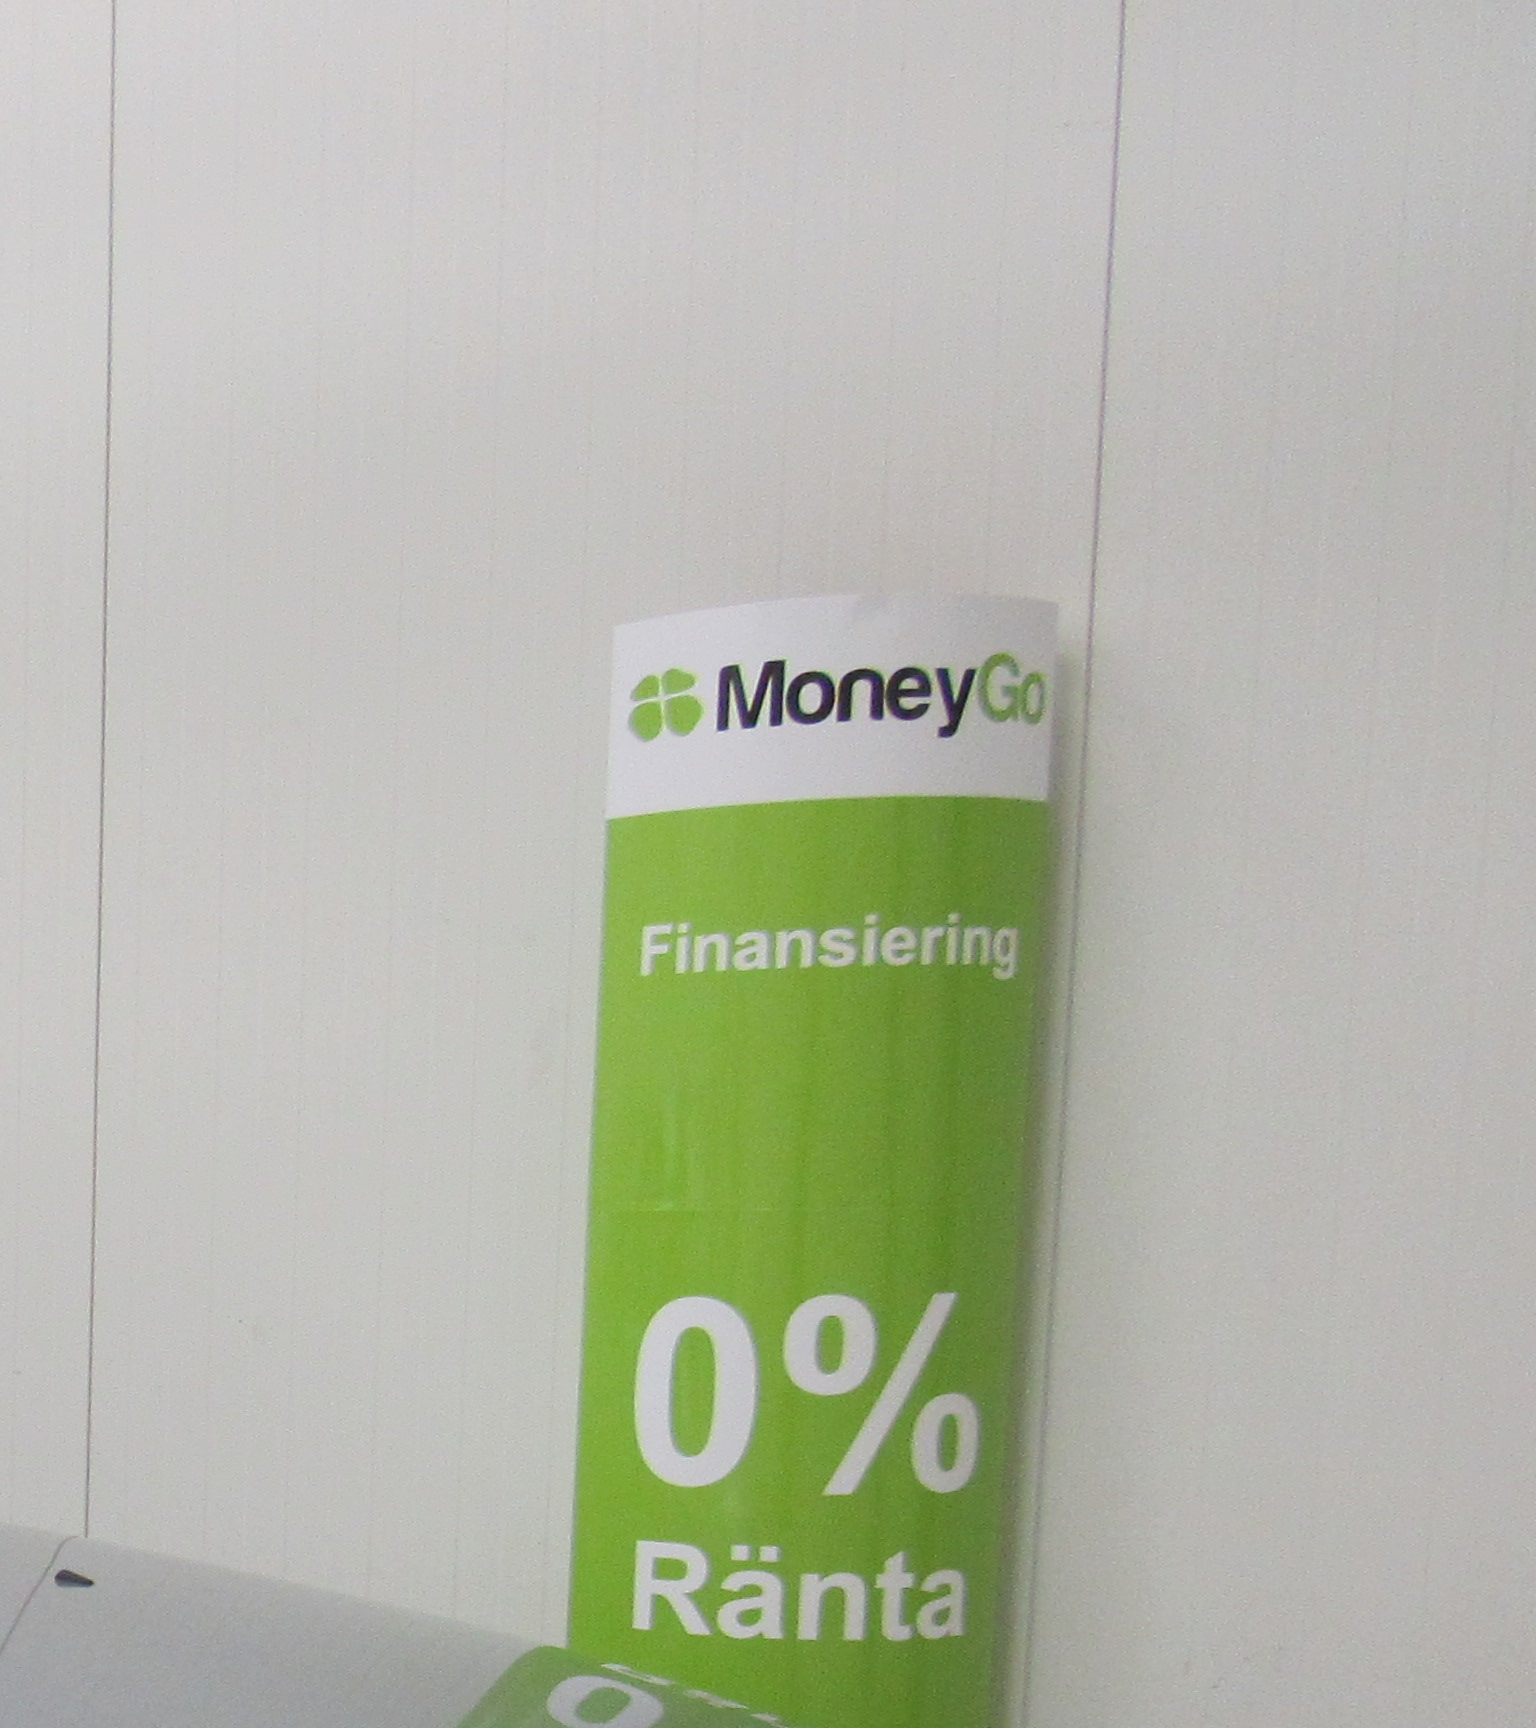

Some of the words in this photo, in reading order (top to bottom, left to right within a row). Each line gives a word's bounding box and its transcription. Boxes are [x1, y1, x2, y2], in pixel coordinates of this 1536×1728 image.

[716, 652, 1046, 738] MoneyGo
[639, 914, 1019, 979] Finansiering
[634, 1291, 982, 1496] 0%
[631, 1539, 966, 1642] Ränta
